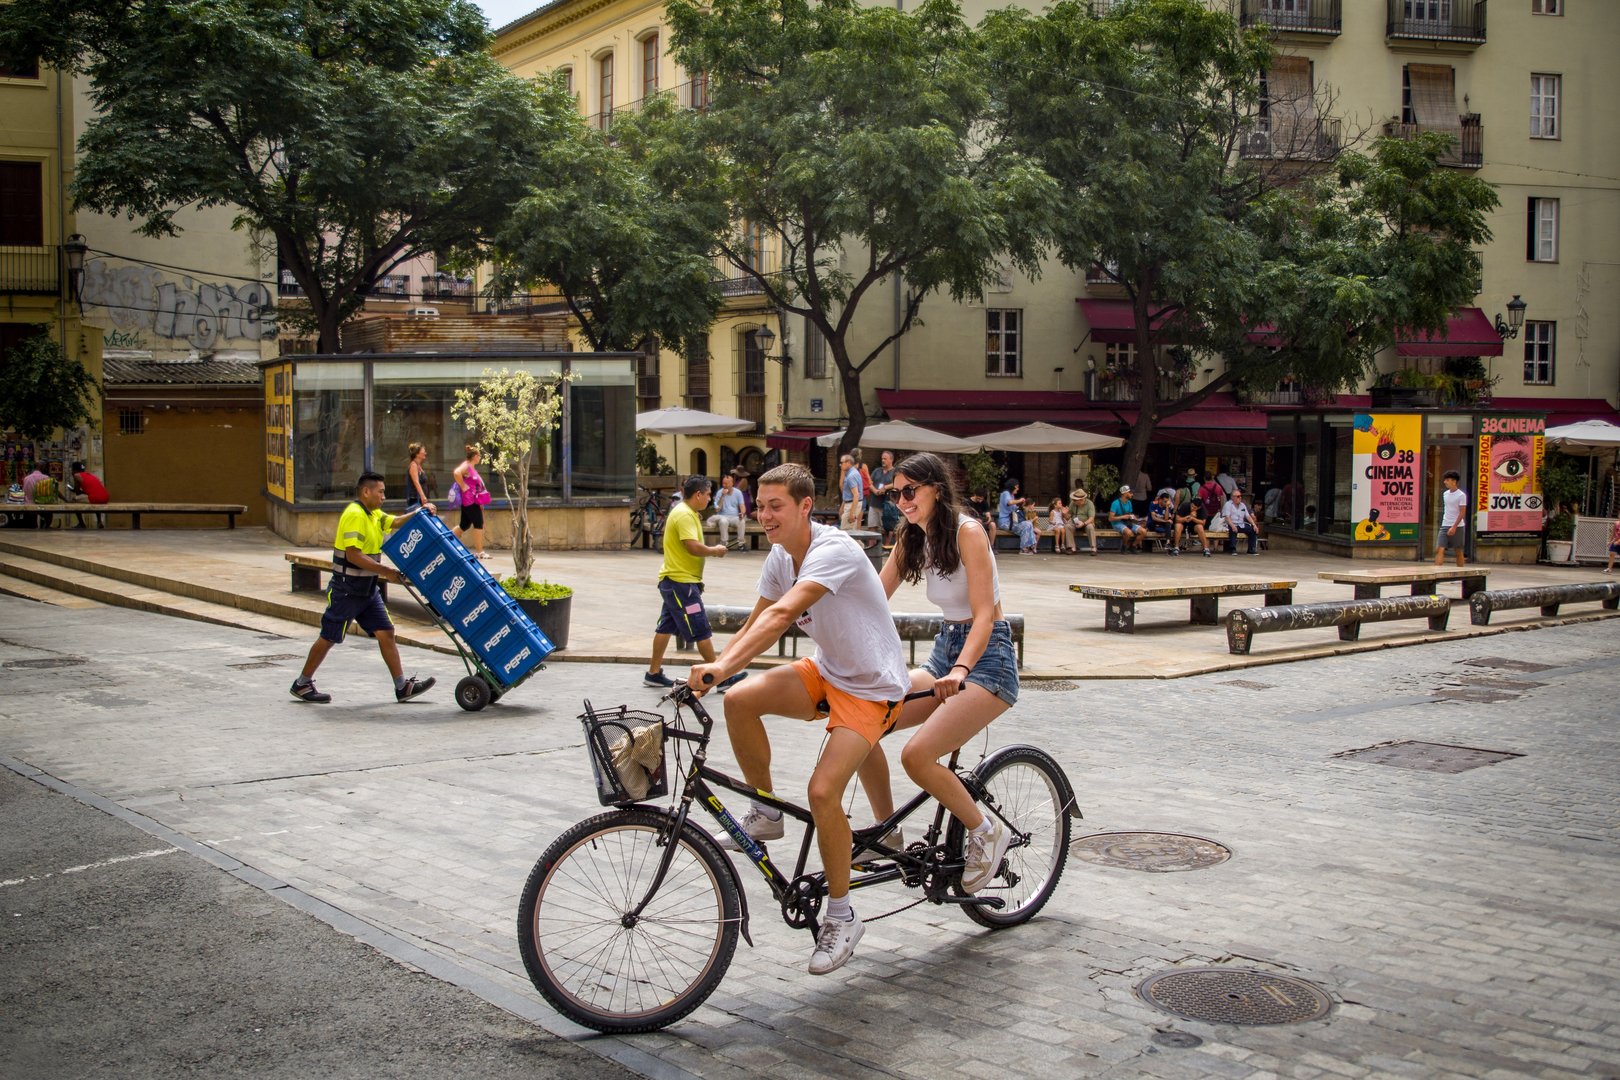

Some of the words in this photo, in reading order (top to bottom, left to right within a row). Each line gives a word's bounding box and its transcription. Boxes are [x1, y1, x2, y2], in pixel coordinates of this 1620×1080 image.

[1398, 449, 1415, 464] 38
[1365, 465, 1414, 480] CINEMA
[1381, 481, 1414, 495] JOVE
[1491, 495, 1522, 510] JOVE
[420, 552, 446, 580] PEPSI
[462, 599, 489, 627] PEPSI
[484, 624, 511, 652] PEPSI
[504, 646, 531, 674] PEPSI
[719, 814, 736, 831] BIKE
[734, 831, 752, 850] RENT
